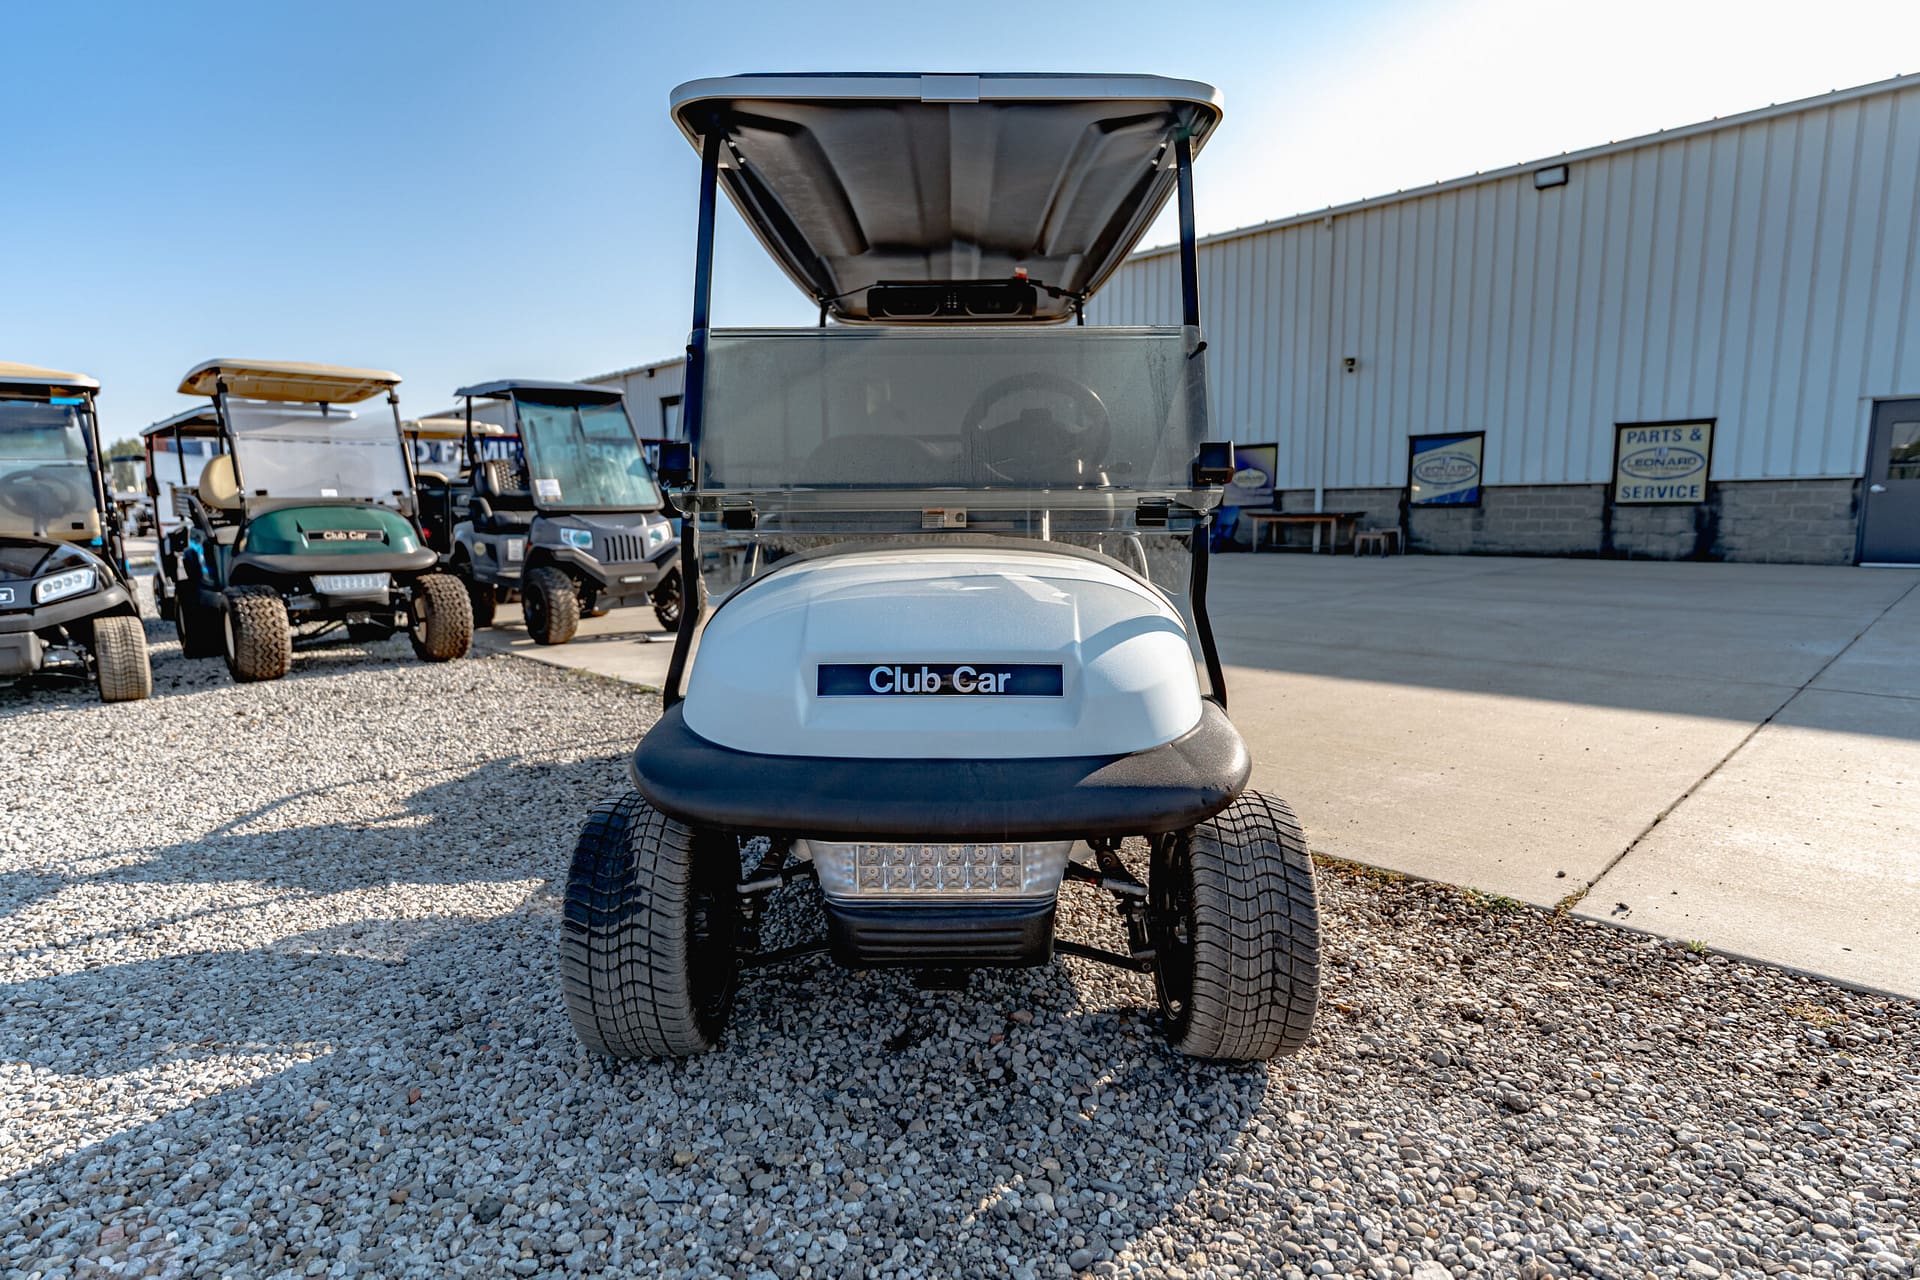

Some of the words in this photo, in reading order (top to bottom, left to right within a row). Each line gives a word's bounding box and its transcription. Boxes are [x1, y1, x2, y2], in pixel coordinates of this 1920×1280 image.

[1626, 428, 1682, 444] PARTS
[1689, 427, 1702, 441] &
[1622, 485, 1700, 499] SERVICE
[323, 530, 347, 540] Club
[349, 530, 368, 540] Car
[869, 665, 941, 693] Club
[952, 665, 1012, 693] Car
